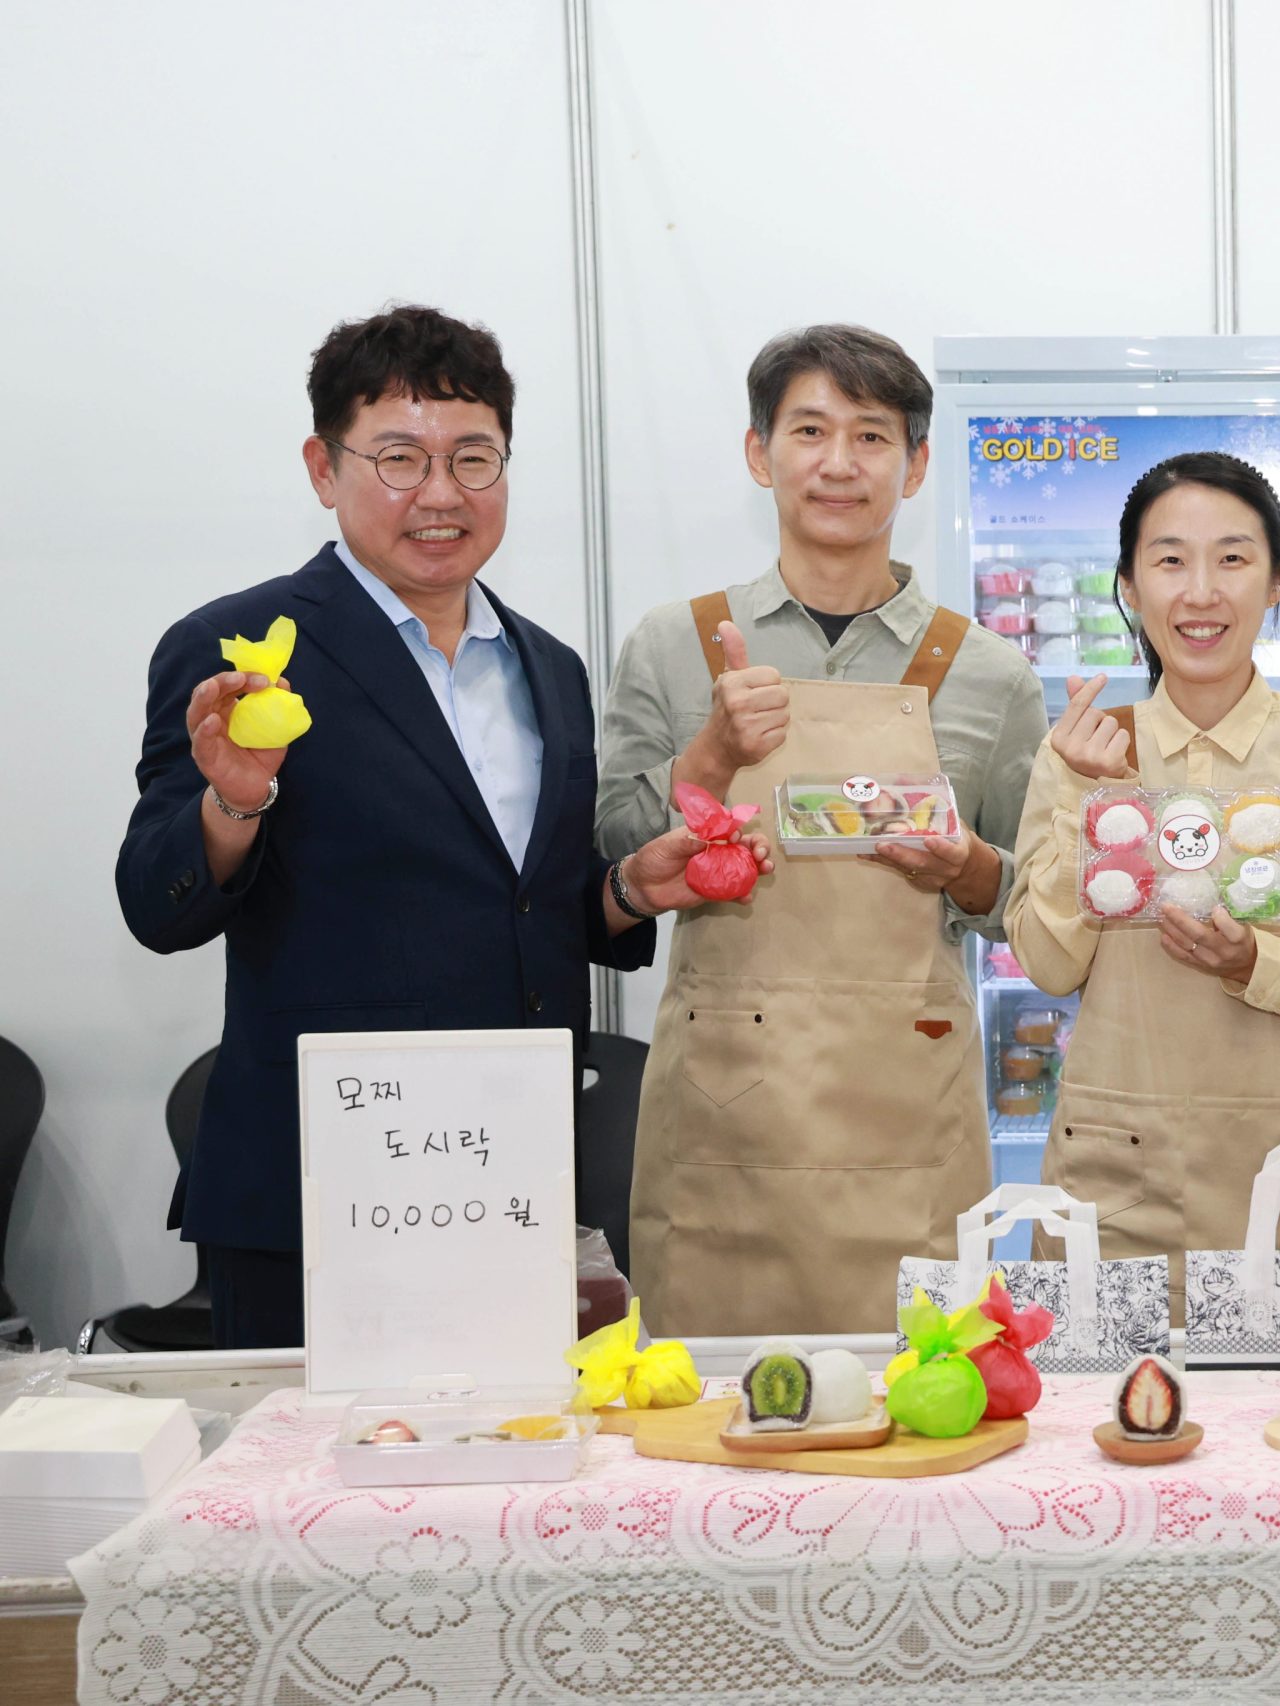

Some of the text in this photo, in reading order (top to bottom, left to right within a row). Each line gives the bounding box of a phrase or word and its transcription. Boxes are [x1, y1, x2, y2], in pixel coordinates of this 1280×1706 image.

[982, 437, 1119, 461] GOLD ICE
[337, 1077, 402, 1111] 모찌
[385, 1127, 490, 1166] 도시락
[351, 1199, 486, 1234] 10,000
